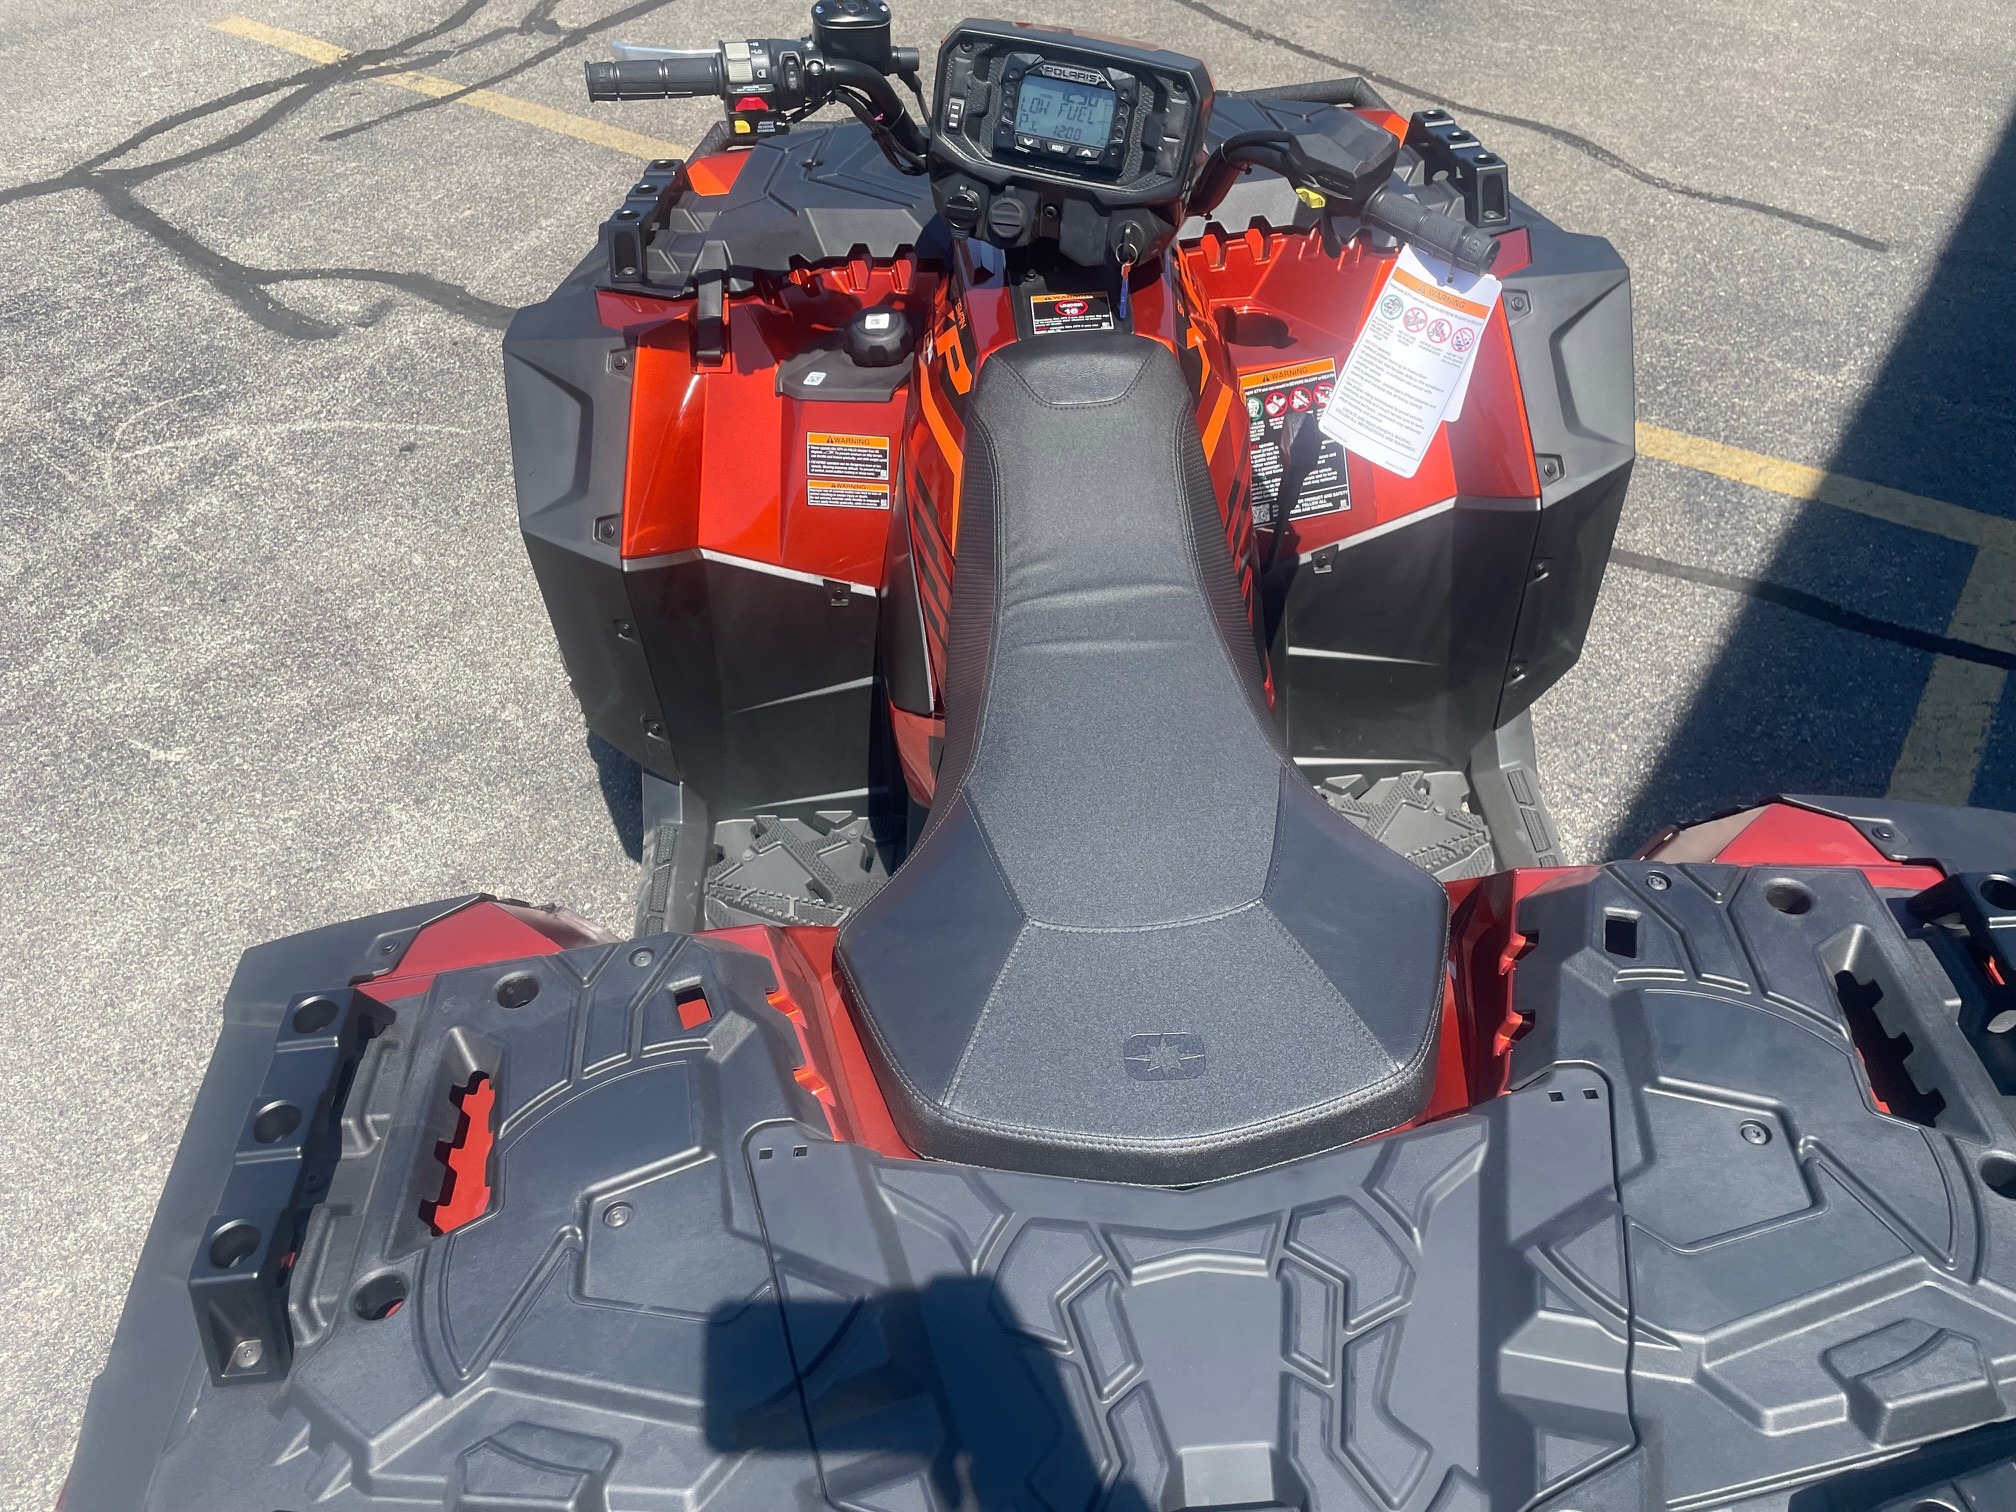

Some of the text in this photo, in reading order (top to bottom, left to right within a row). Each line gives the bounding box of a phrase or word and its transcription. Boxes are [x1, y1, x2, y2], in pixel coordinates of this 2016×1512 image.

[1045, 67, 1097, 82] POLARIS
[1021, 96, 1094, 124] LOW FUEL
[1054, 125, 1082, 140] 1200
[1427, 288, 1465, 309] WARNING
[1271, 367, 1307, 379] WARNING
